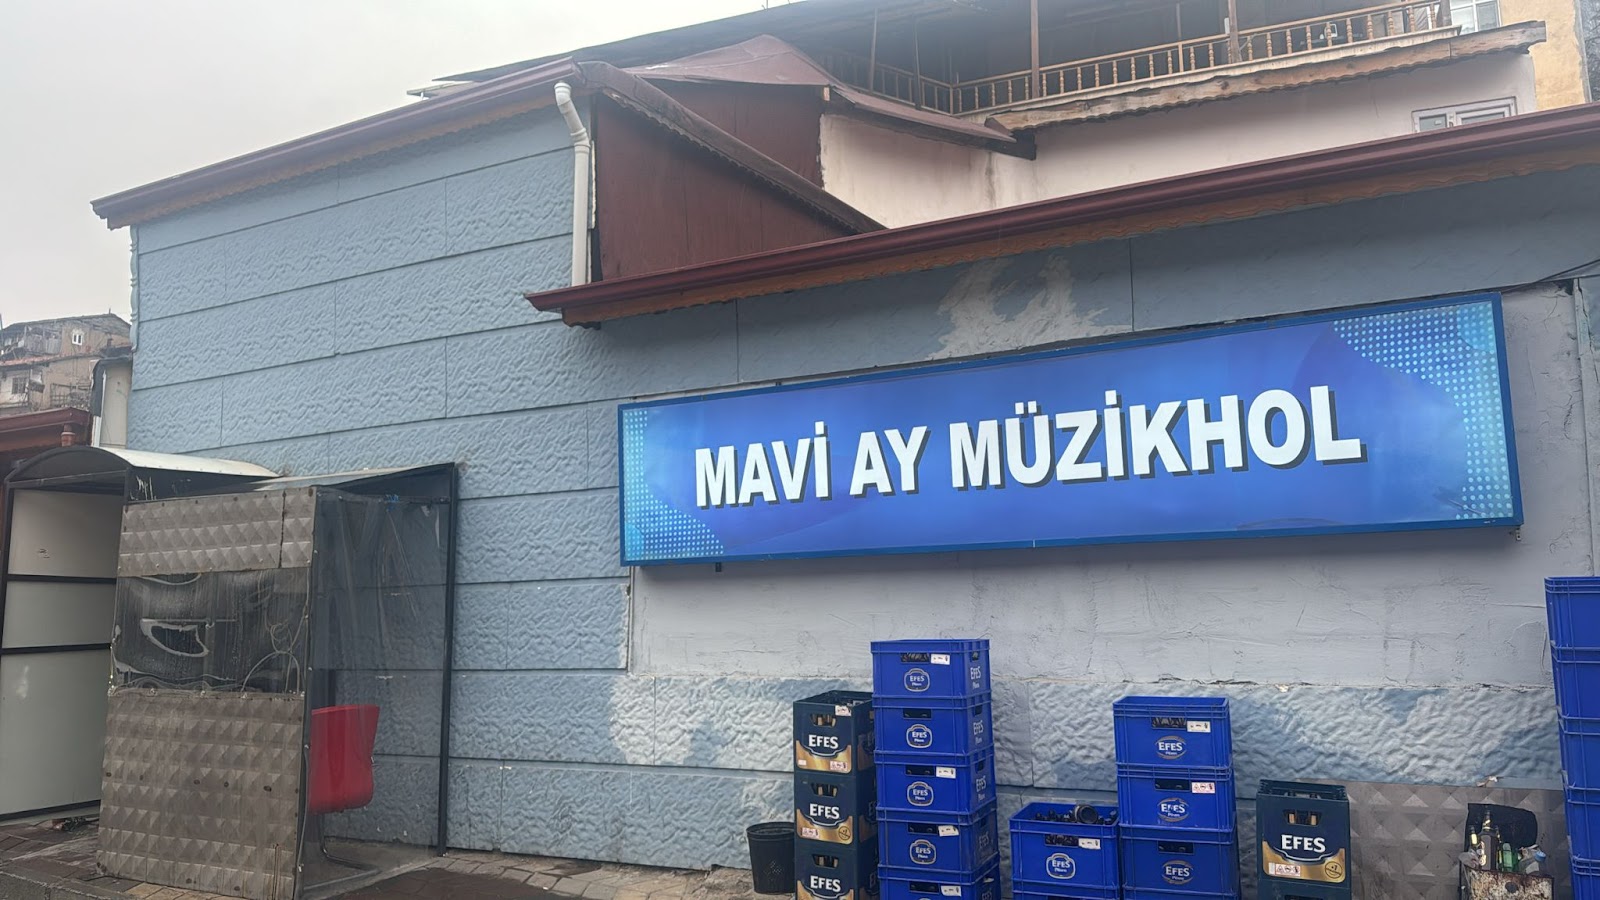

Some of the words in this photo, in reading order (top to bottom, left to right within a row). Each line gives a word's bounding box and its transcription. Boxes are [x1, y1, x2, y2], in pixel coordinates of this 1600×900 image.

[695, 421, 829, 507] MAVİ
[849, 425, 928, 496] AY
[949, 385, 1362, 489] MÜZİKHOL
[808, 734, 839, 750] EFES
[1158, 742, 1183, 752] EFES
[809, 803, 840, 820] EFES
[1281, 834, 1326, 853] EFES
[1165, 866, 1190, 877] EFES
[810, 875, 841, 893] EFES
